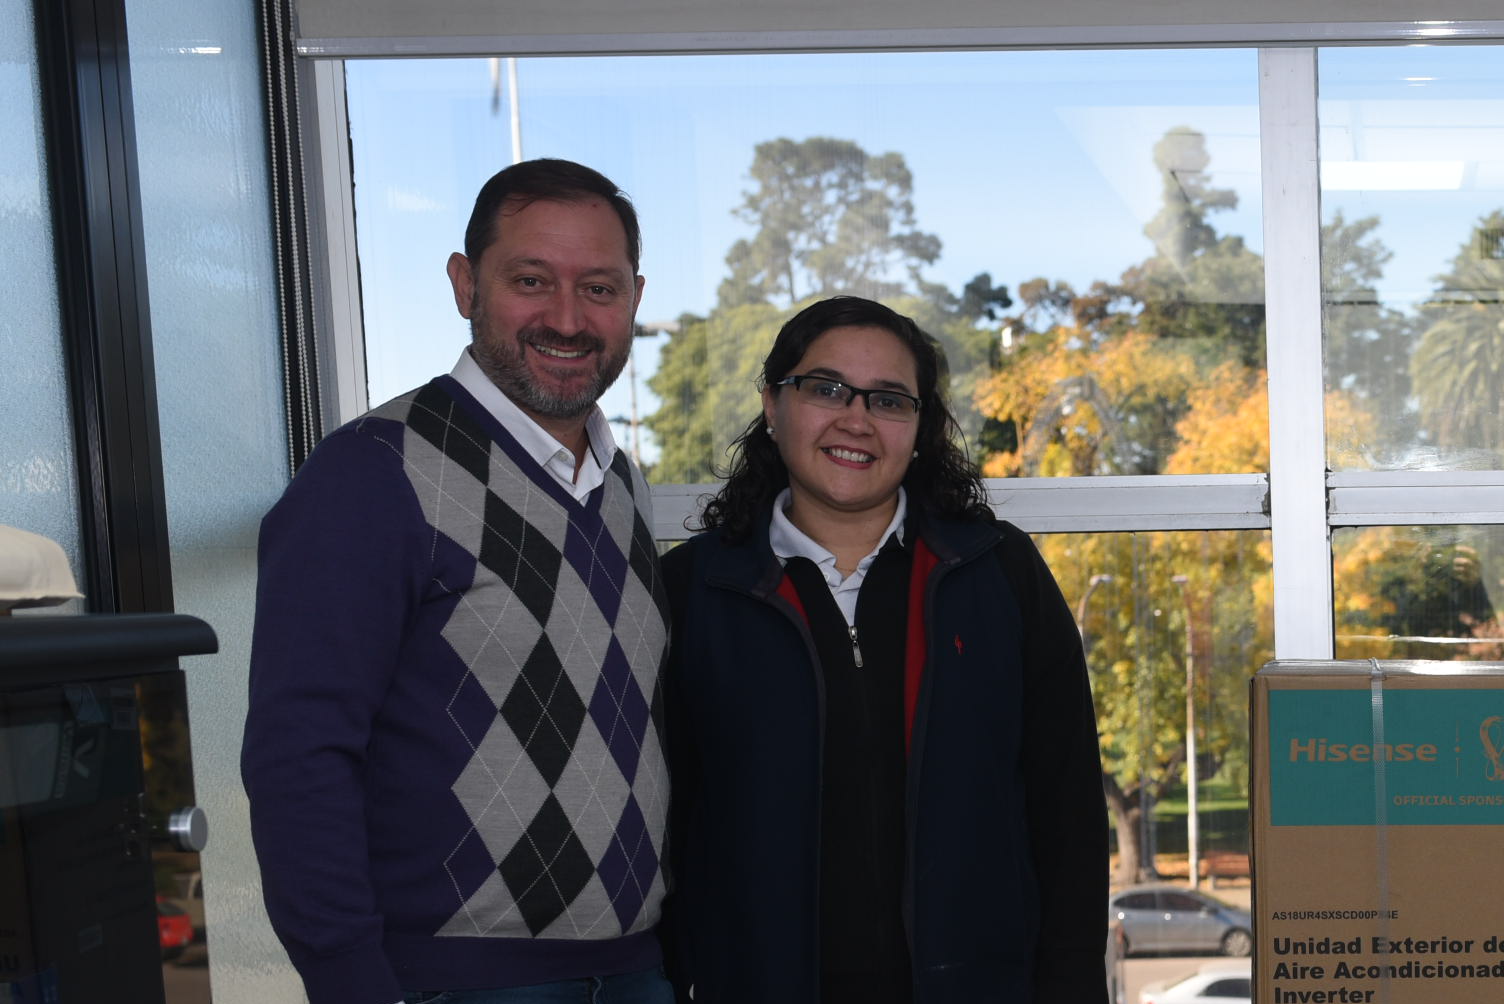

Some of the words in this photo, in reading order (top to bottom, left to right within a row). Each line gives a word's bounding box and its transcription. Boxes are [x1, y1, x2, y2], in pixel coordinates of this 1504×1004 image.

[1289, 738, 1437, 762] Hisense
[1394, 796, 1456, 806] OFFICIAL
[1273, 937, 1361, 955] Unidad
[1372, 937, 1474, 954] Exterior
[1273, 962, 1325, 979] Aire
[1274, 987, 1374, 1004] Inverter
